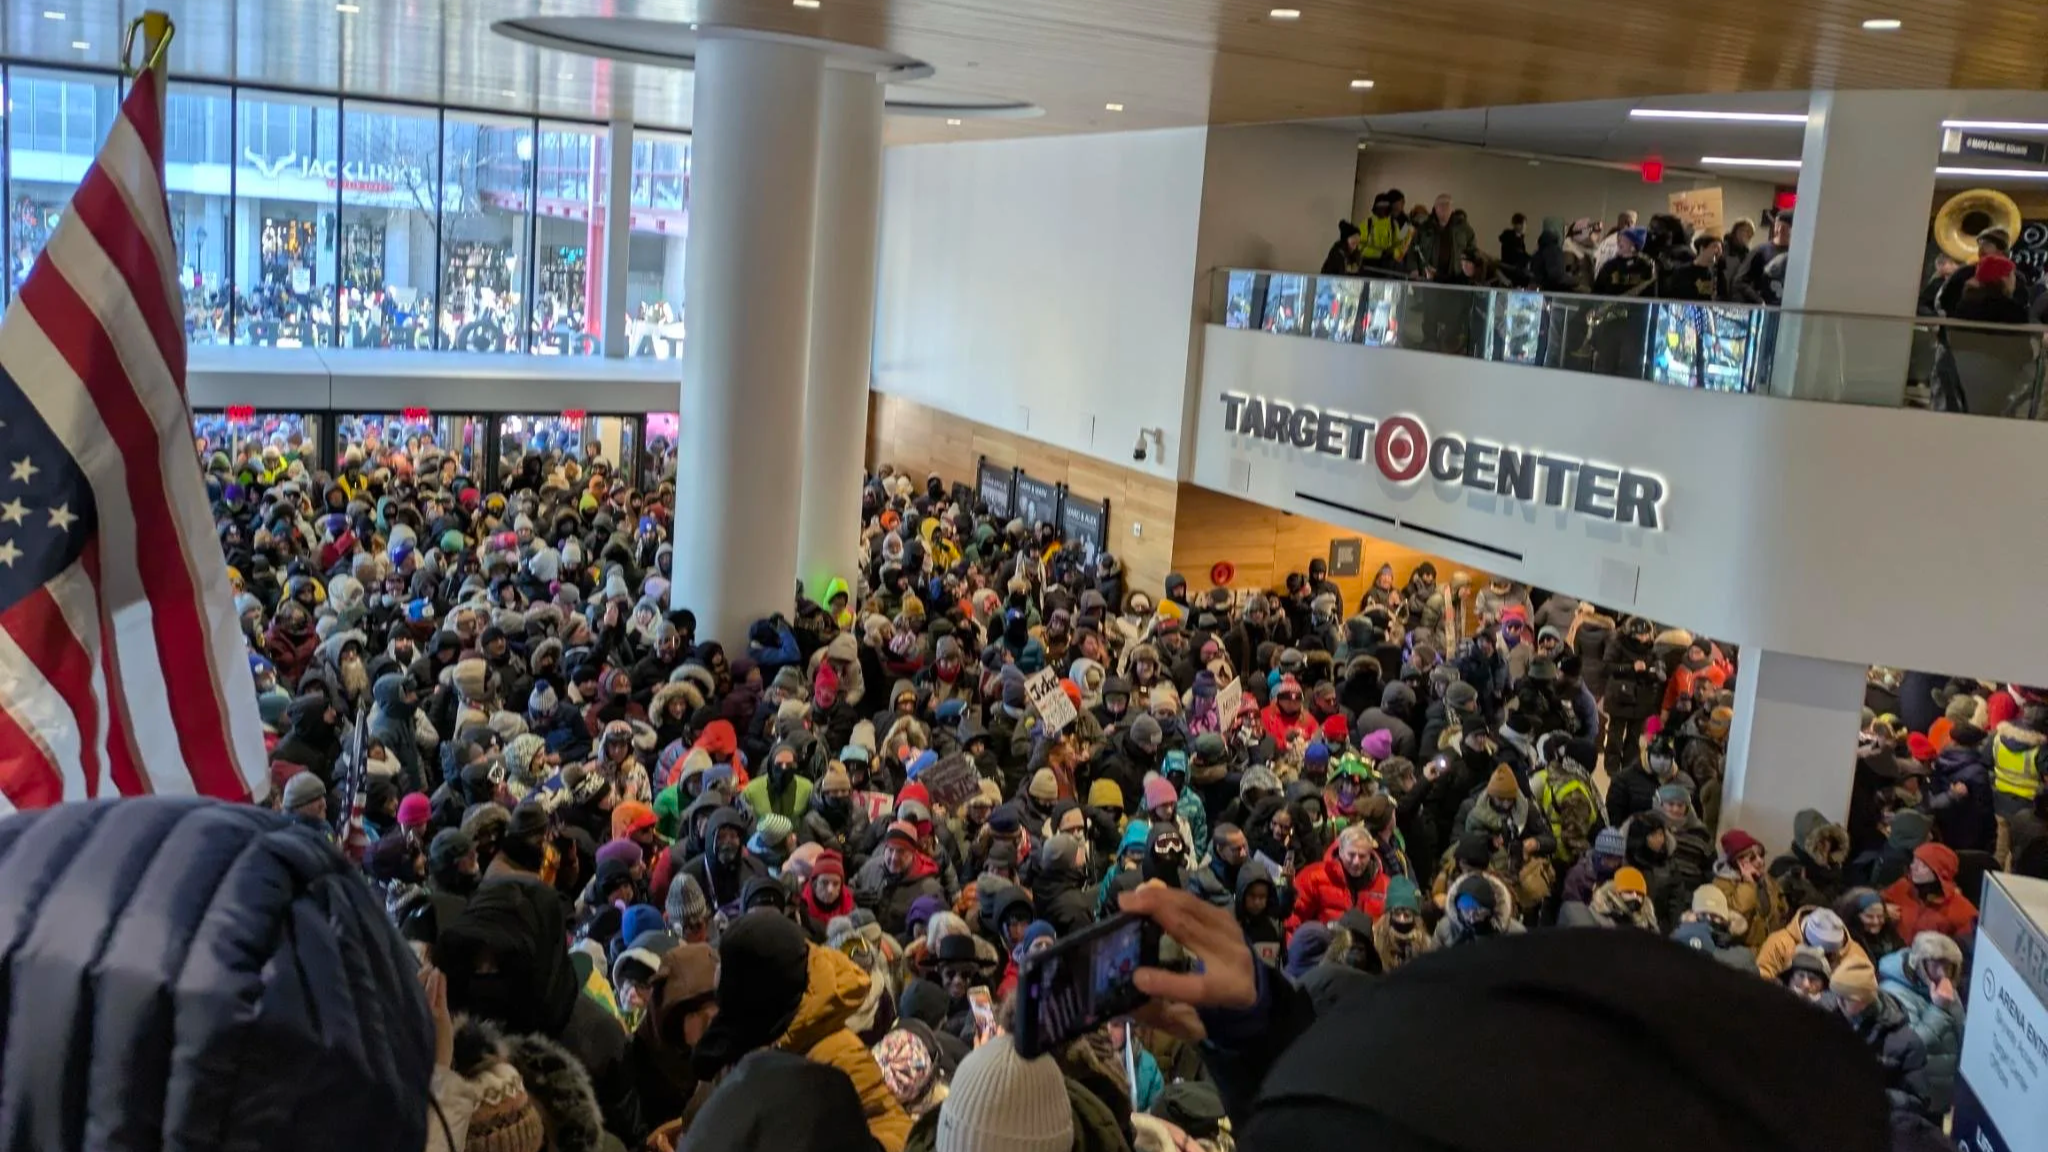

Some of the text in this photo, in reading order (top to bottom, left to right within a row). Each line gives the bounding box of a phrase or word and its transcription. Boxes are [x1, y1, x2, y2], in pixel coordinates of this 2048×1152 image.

[1220, 392, 1665, 529] TARGET CENTER
[1998, 985, 2026, 1034] ARENA
